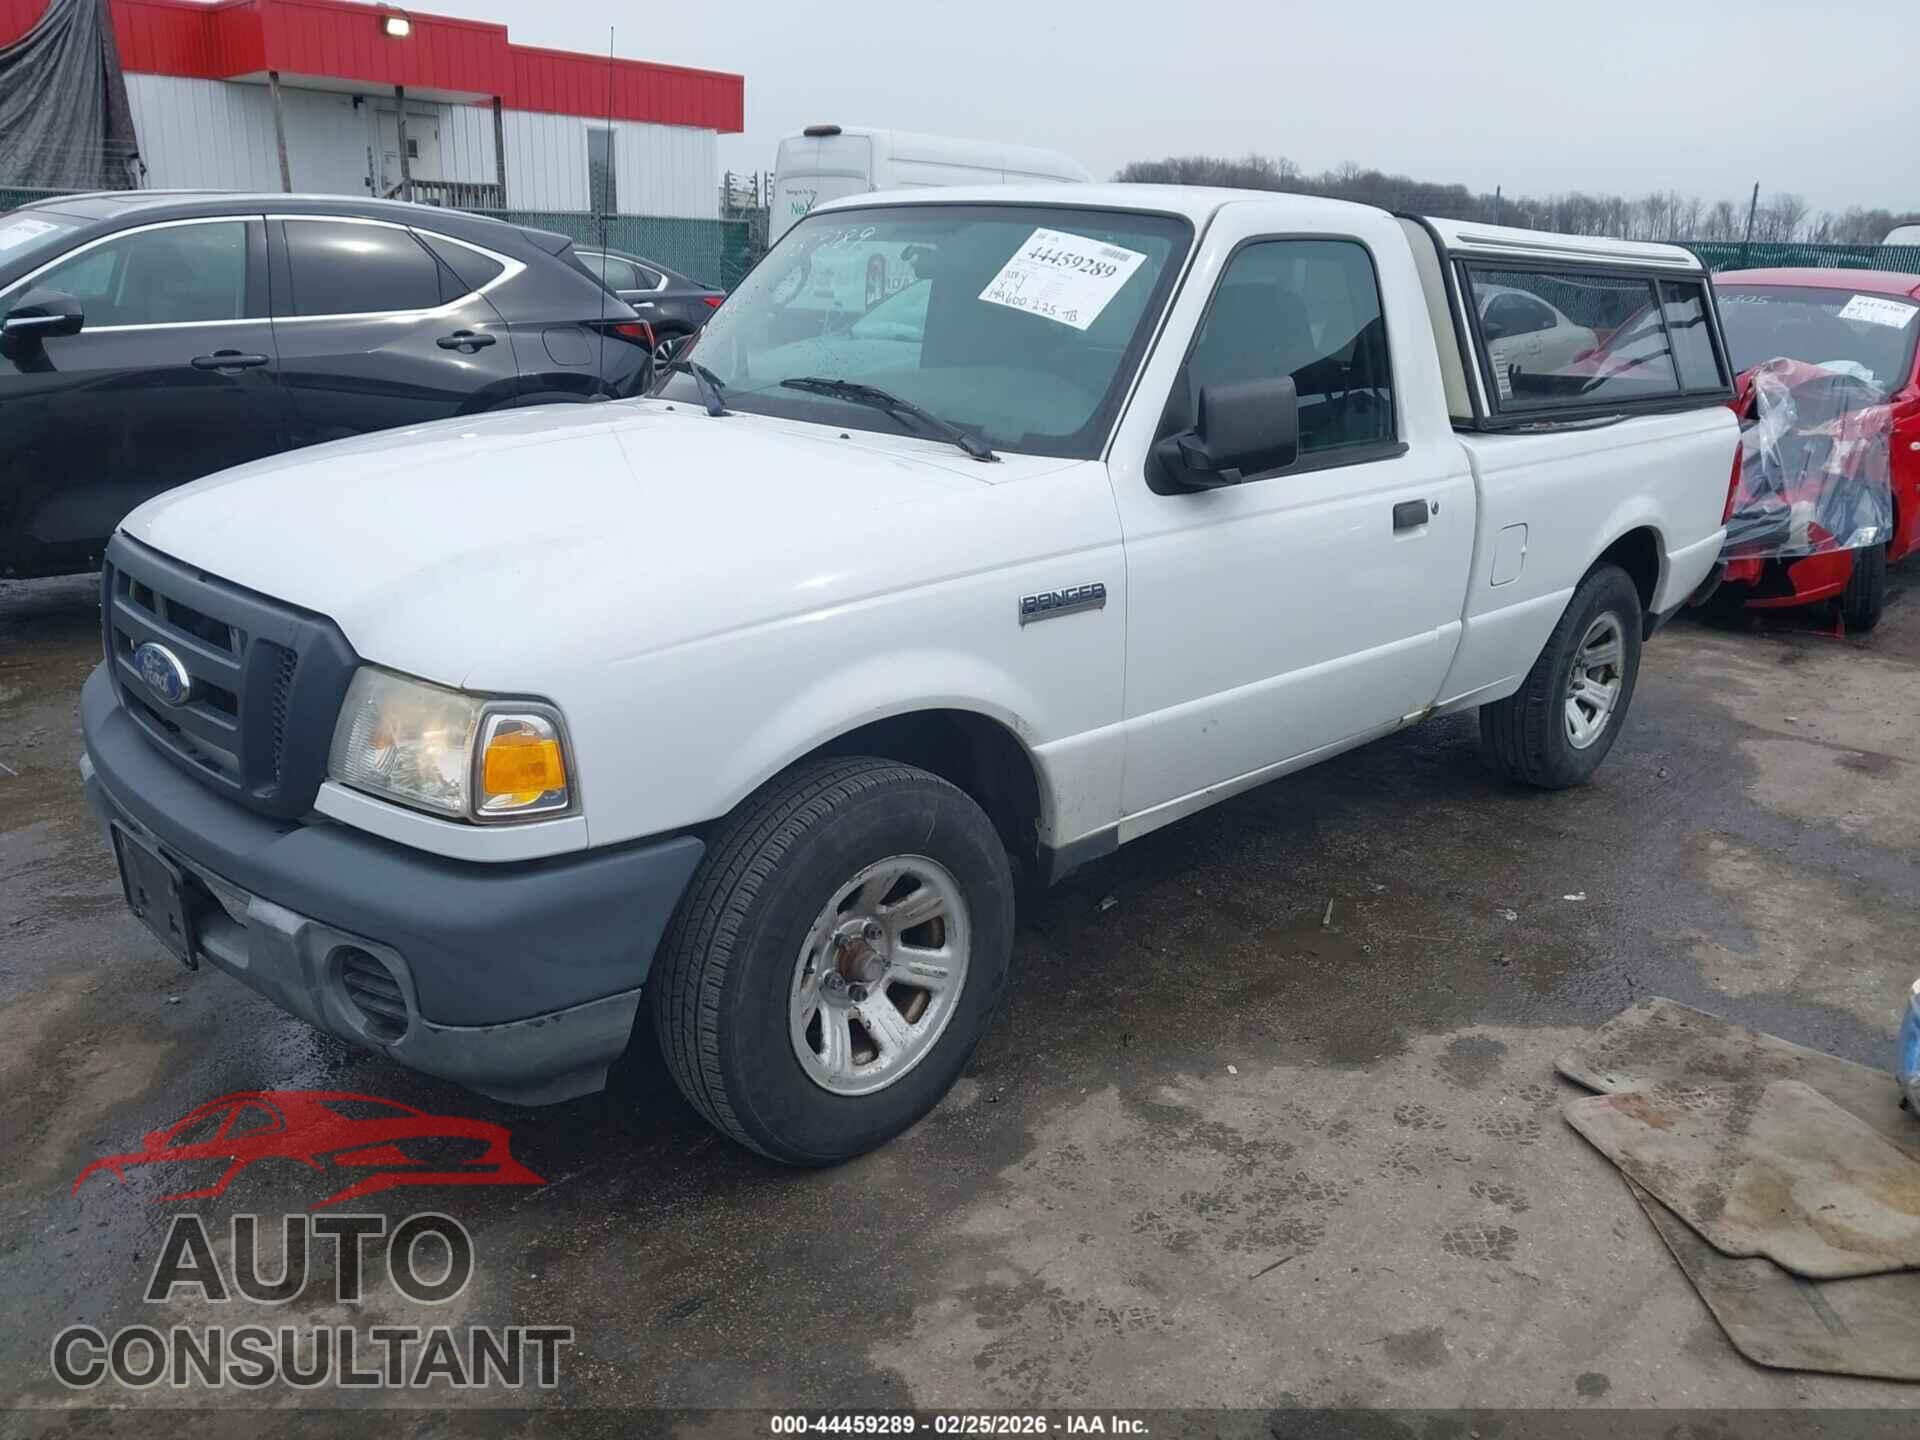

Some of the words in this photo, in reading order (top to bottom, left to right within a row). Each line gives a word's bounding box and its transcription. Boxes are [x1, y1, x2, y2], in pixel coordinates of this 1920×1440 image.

[1028, 246, 1118, 279] 44459289
[1021, 582, 1105, 615] RANGER
[142, 651, 170, 693] Ford
